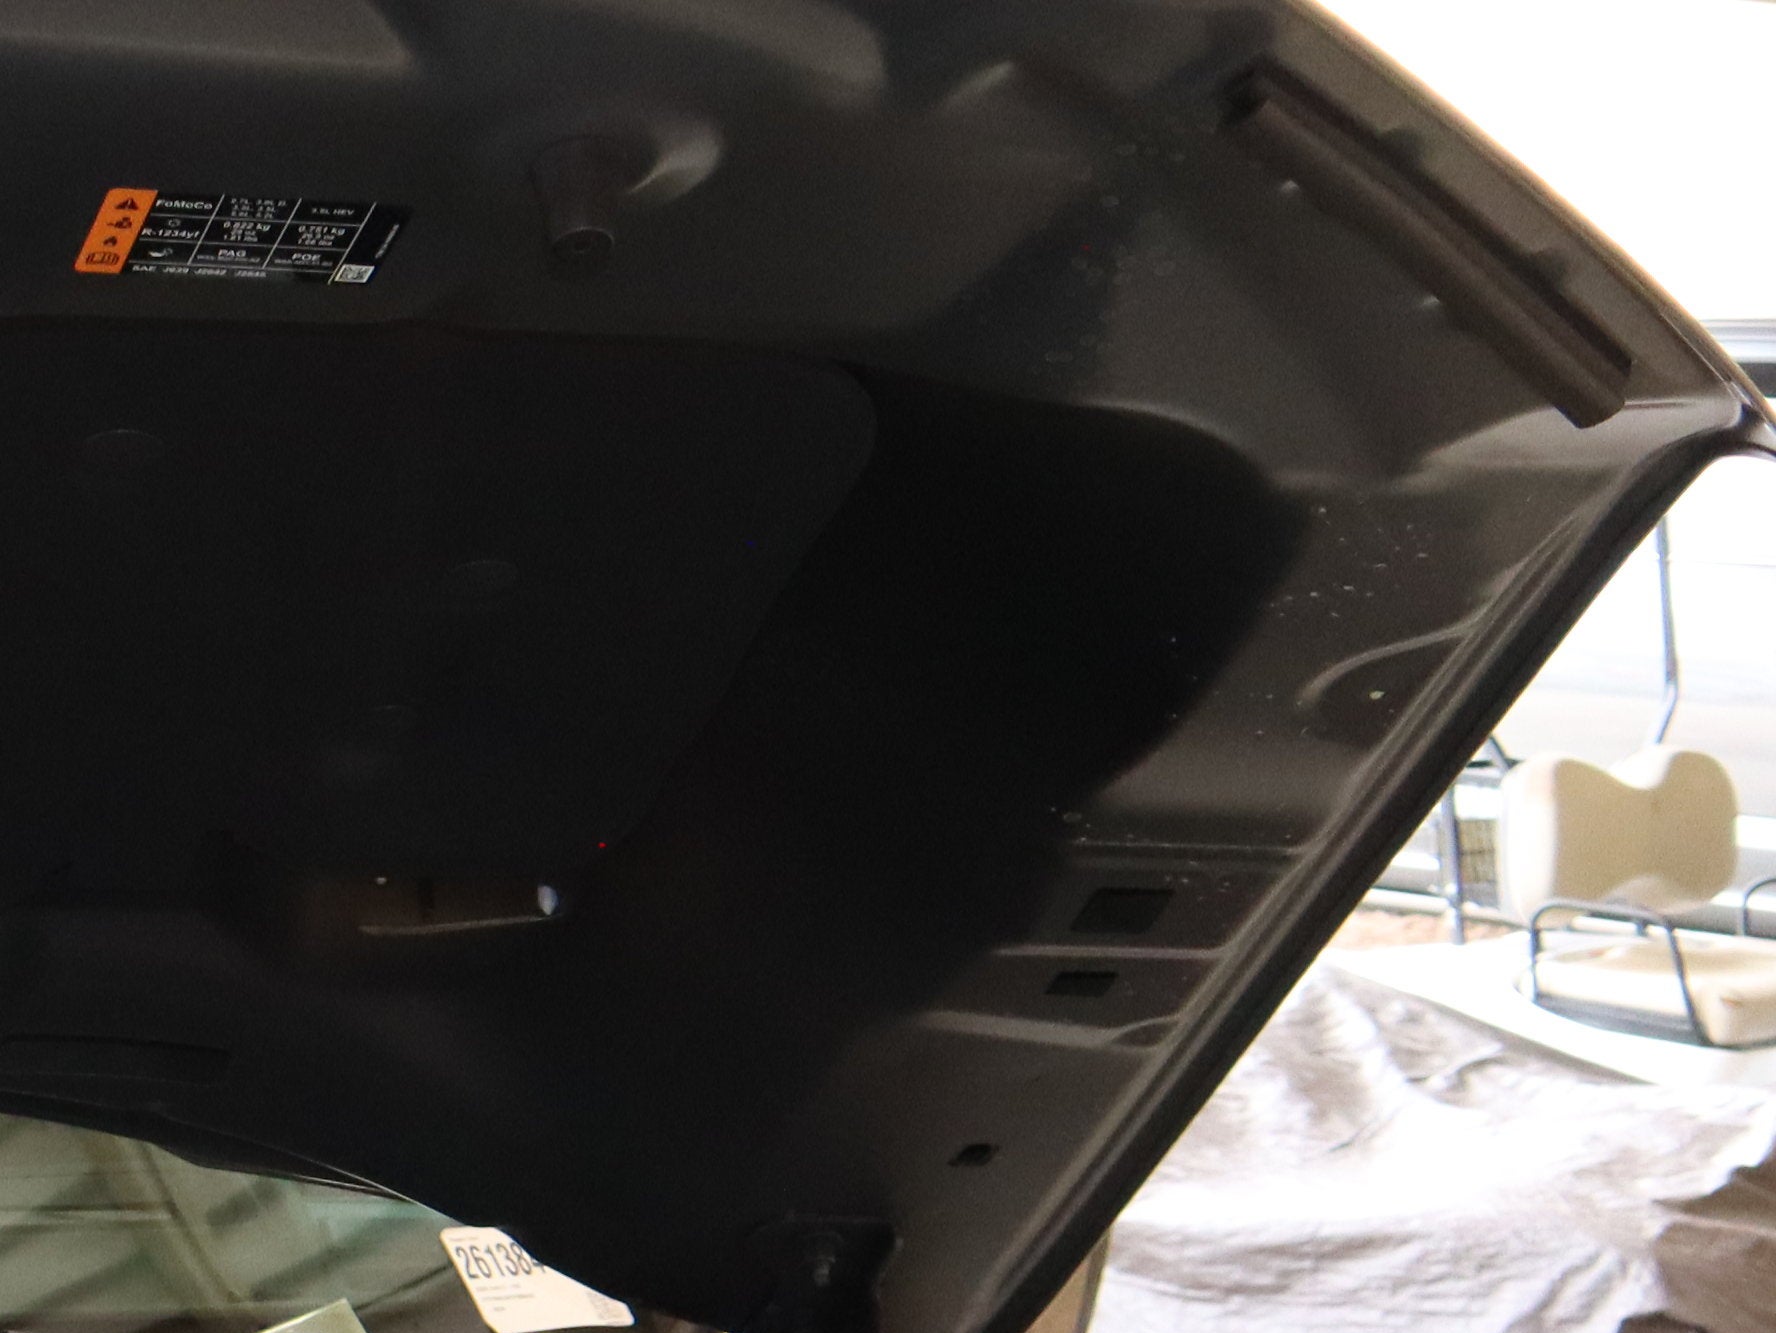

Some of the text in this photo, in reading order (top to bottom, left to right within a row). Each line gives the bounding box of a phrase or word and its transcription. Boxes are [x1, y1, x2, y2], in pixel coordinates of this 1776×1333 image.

[155, 199, 213, 210] FoMoCo
[256, 222, 272, 232] kg
[331, 227, 346, 236] kg
[141, 228, 200, 239] R-1234yf
[217, 249, 247, 257] PAG
